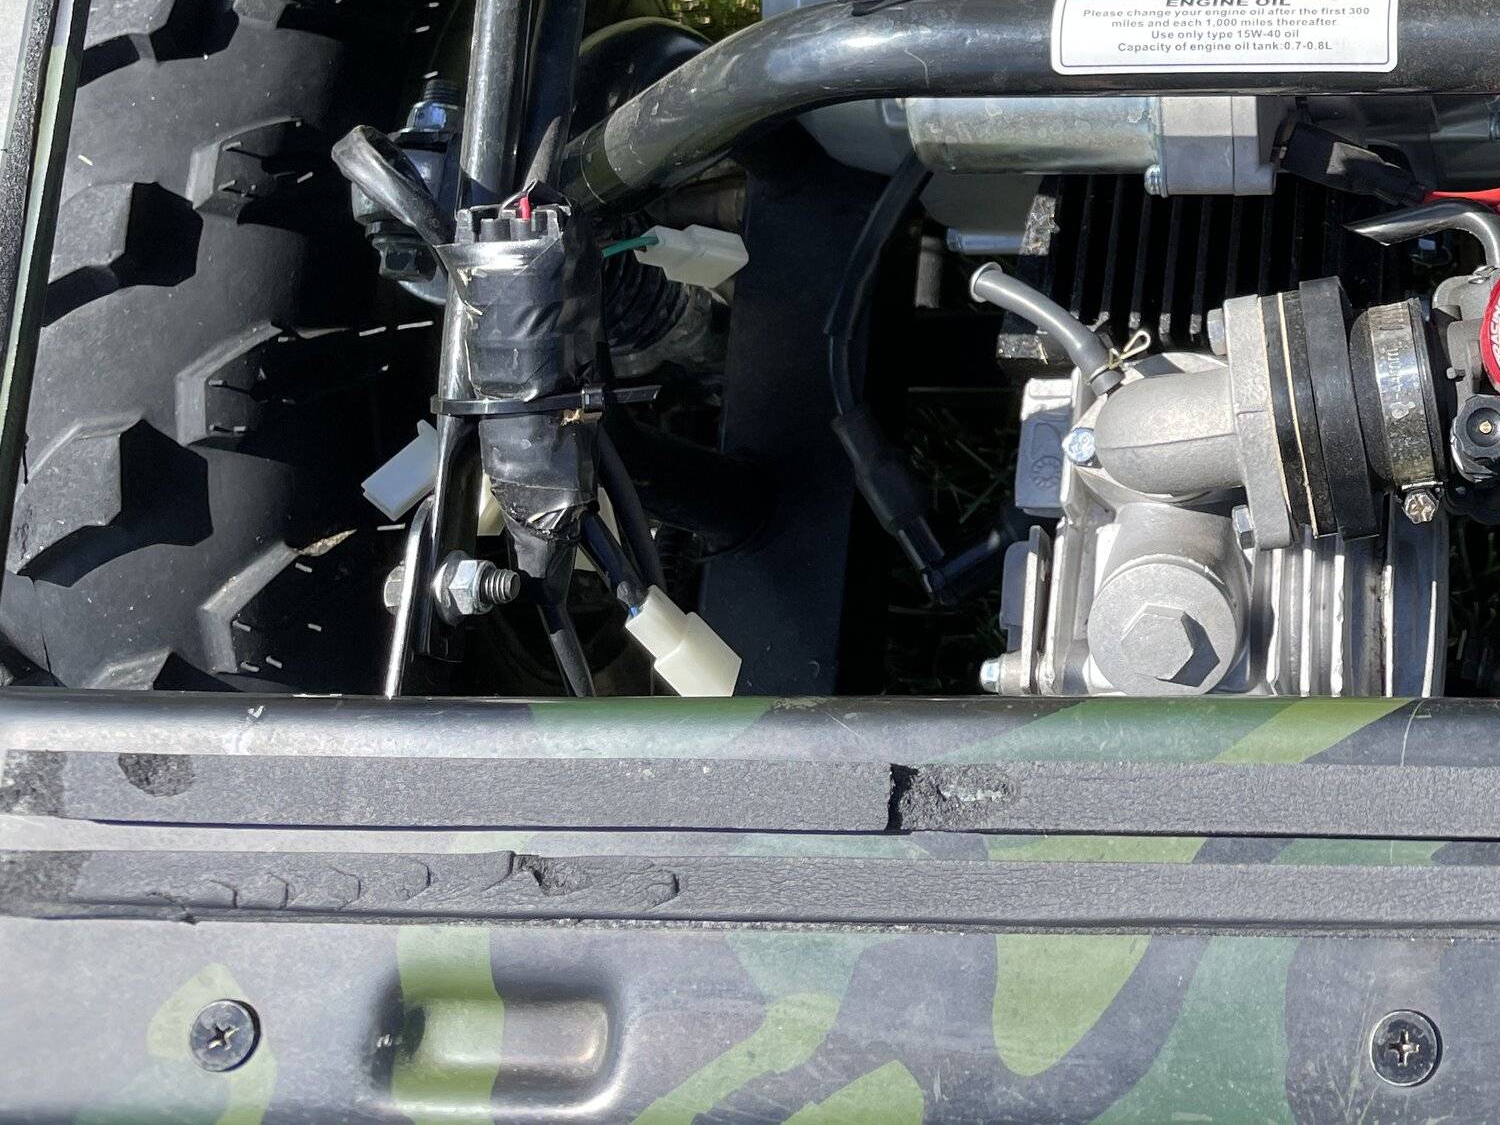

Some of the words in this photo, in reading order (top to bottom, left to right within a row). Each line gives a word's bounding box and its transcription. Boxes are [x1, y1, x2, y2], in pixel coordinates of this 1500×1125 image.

[1083, 9, 1123, 17] Please
[1126, 9, 1171, 18] change
[1174, 9, 1202, 18] your
[1204, 8, 1246, 18] engine
[1249, 8, 1265, 16] oil
[1267, 7, 1296, 15] after
[1299, 7, 1318, 15] the
[1321, 7, 1346, 15] first
[1348, 7, 1370, 15] 300
[1147, 19, 1170, 27] and
[1172, 19, 1202, 27] each
[1205, 18, 1238, 28] 1,000
[1241, 18, 1273, 26] miles
[1151, 30, 1174, 39] Use
[1177, 30, 1203, 40] only
[1207, 30, 1233, 40] type
[1237, 29, 1281, 38] 15W-40
[1284, 29, 1299, 38] oil
[1118, 42, 1171, 53] Capacity
[1175, 42, 1186, 51] of
[1189, 43, 1231, 52] engine
[1234, 42, 1249, 50] oil
